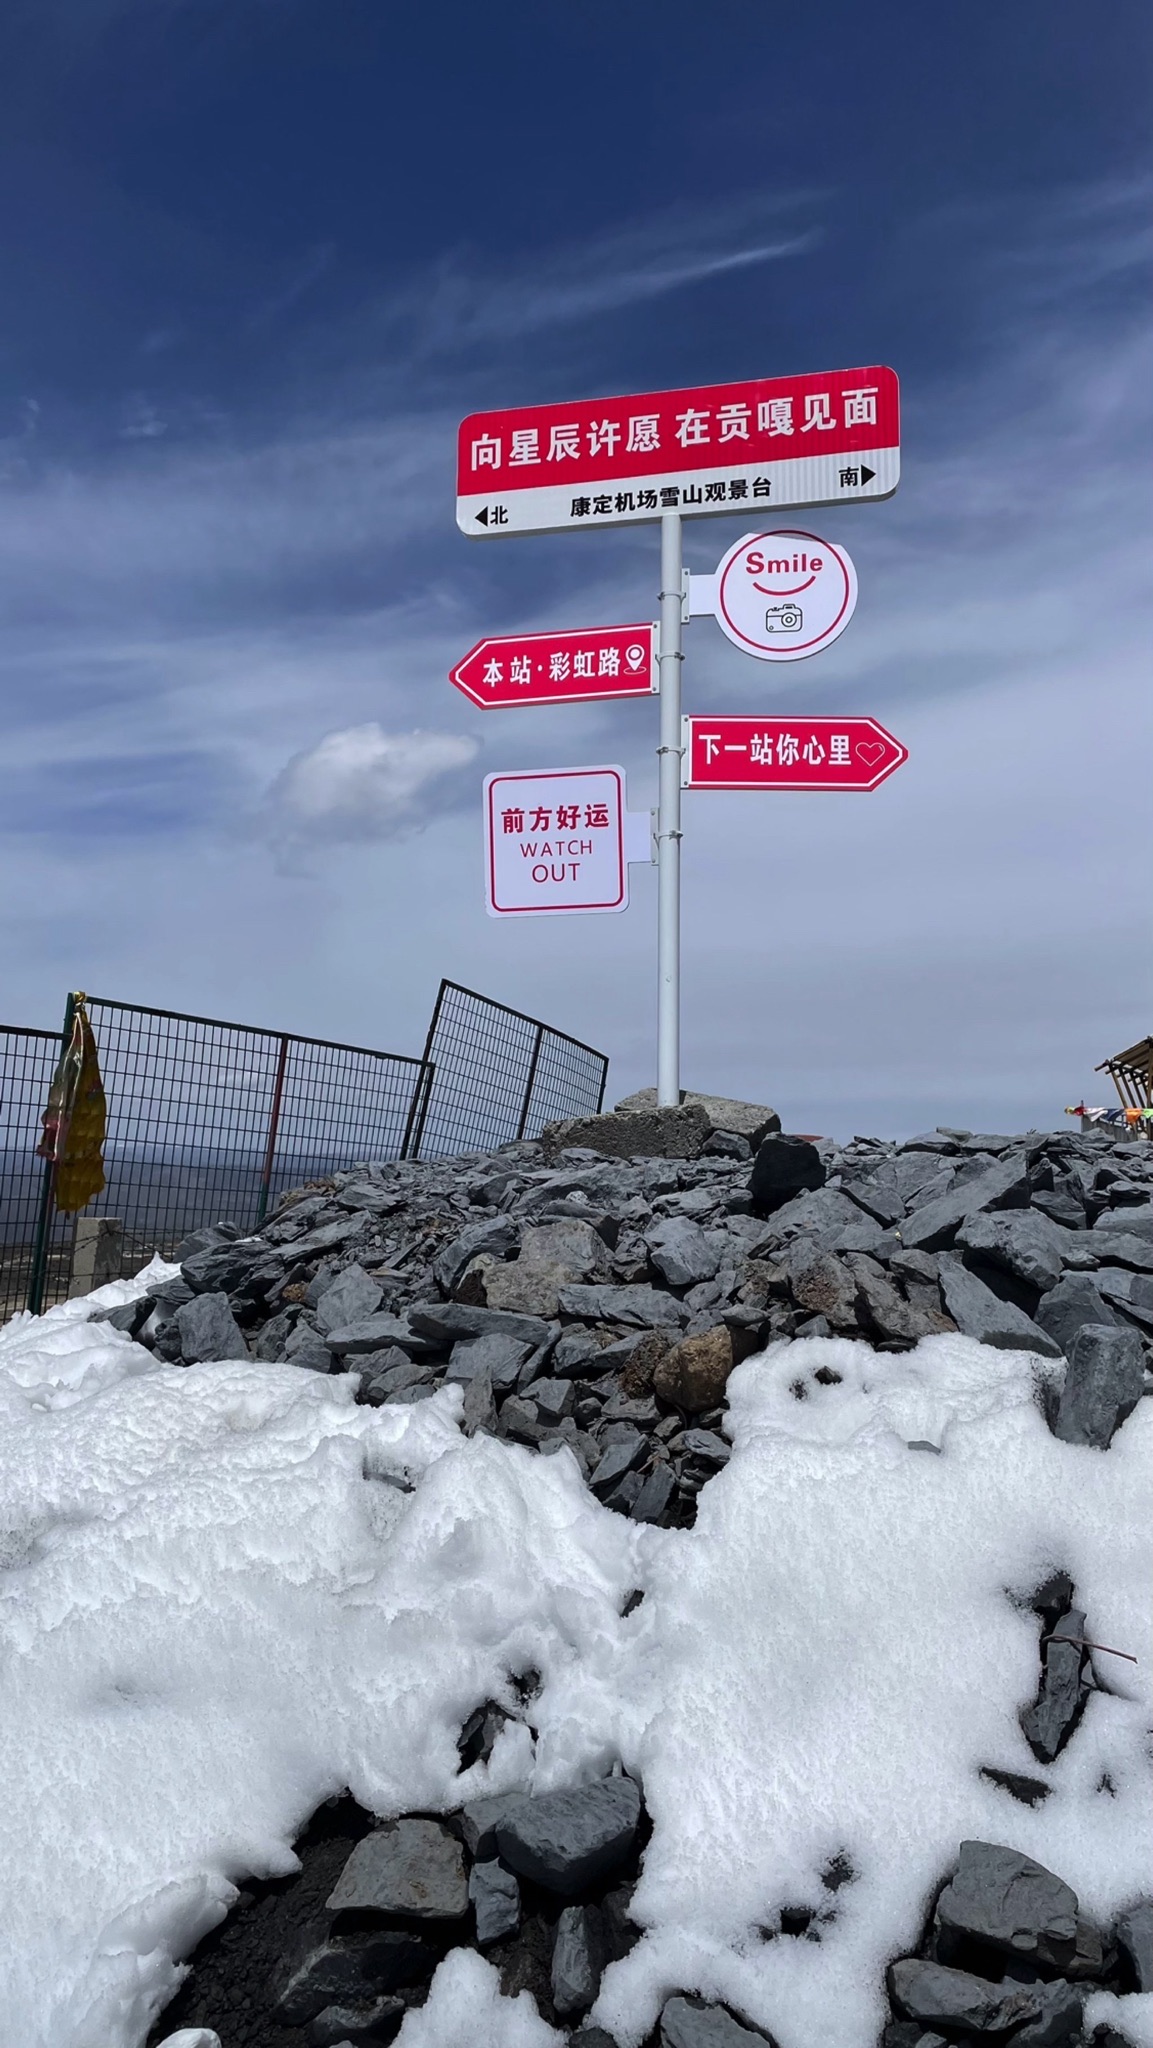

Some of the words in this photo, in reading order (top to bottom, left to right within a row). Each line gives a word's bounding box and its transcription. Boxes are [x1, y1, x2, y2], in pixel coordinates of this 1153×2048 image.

[470, 412, 661, 471] 向星辰许愿
[675, 386, 879, 449] 在贡嘎见面
[838, 466, 859, 487] 南
[570, 476, 773, 518] 康定机场雪山观景台
[490, 505, 509, 526] 北
[745, 551, 824, 575] Smile
[698, 733, 852, 767] 下一站你心里
[500, 803, 610, 834] 前方好运
[520, 839, 593, 858] WATCH
[532, 862, 581, 883] OUT
